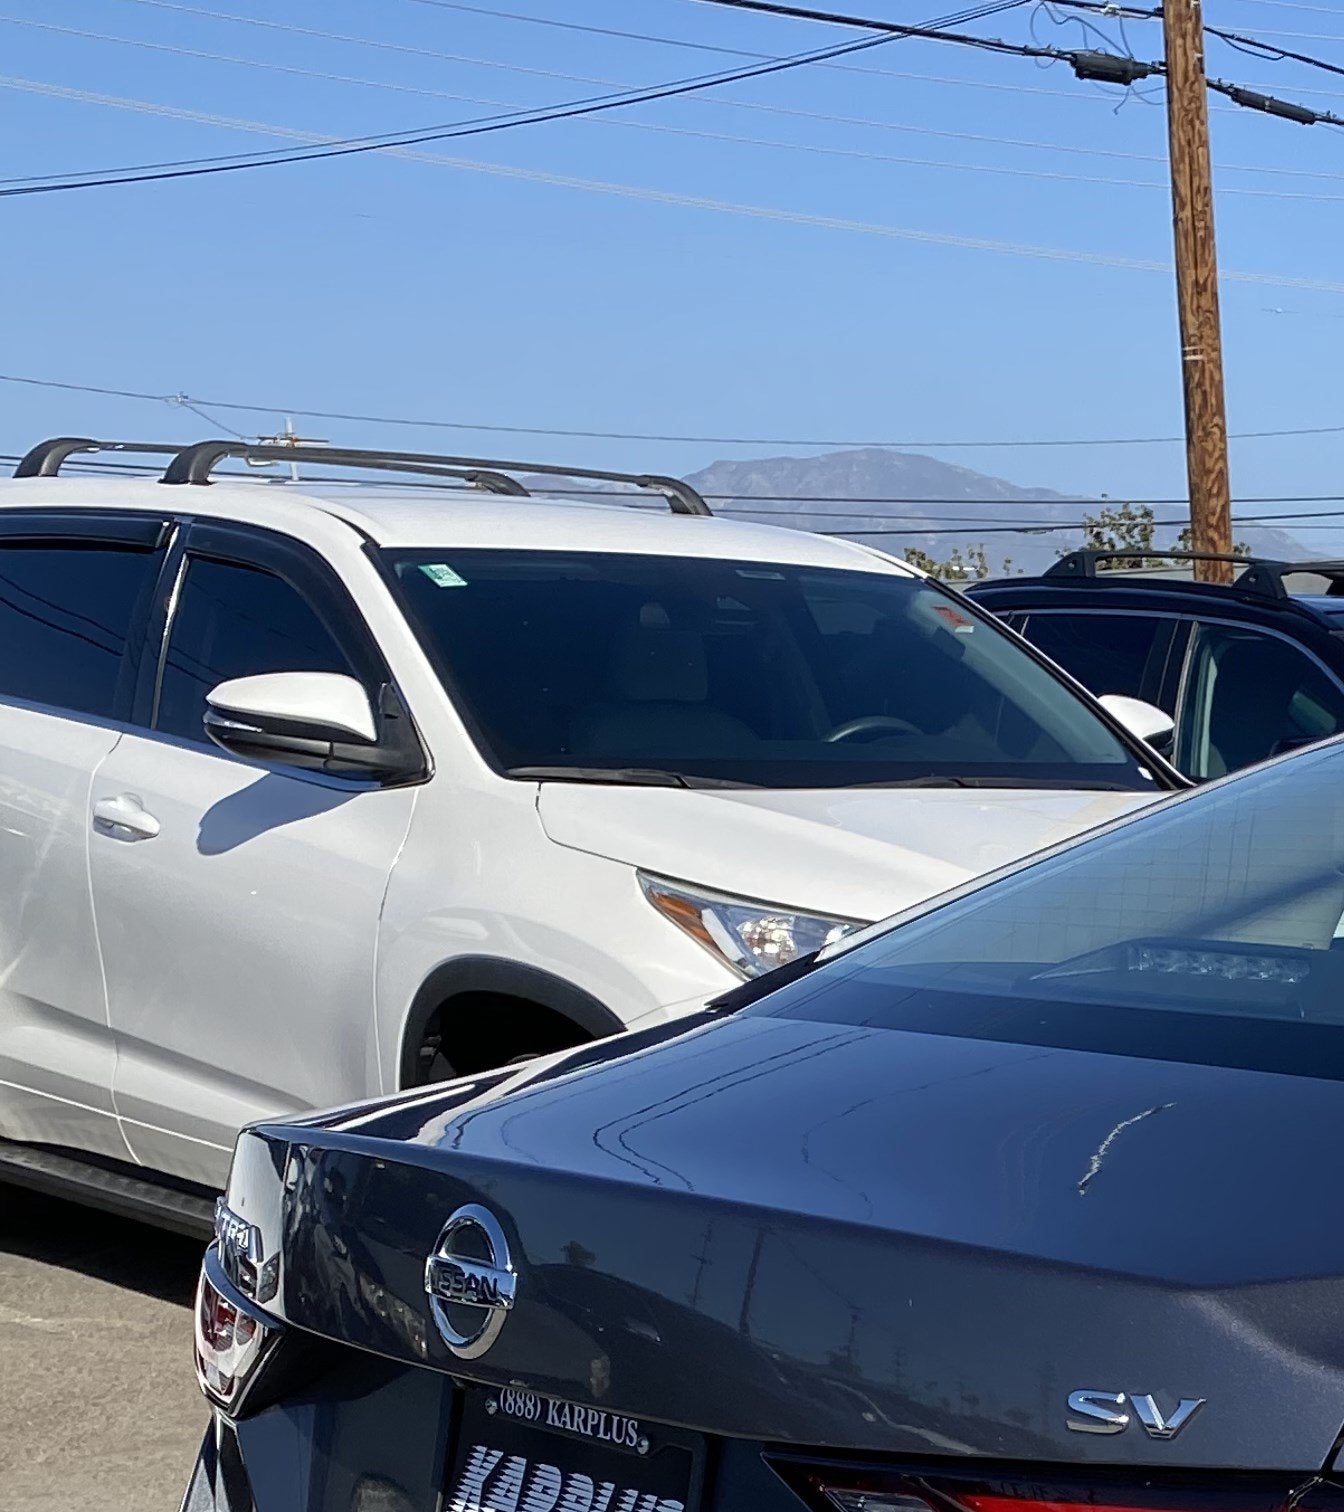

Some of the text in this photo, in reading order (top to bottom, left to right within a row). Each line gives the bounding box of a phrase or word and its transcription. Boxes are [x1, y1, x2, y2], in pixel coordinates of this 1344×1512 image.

[500, 1386, 639, 1448] (888) KARPLUS
[1066, 1388, 1207, 1439] SV
